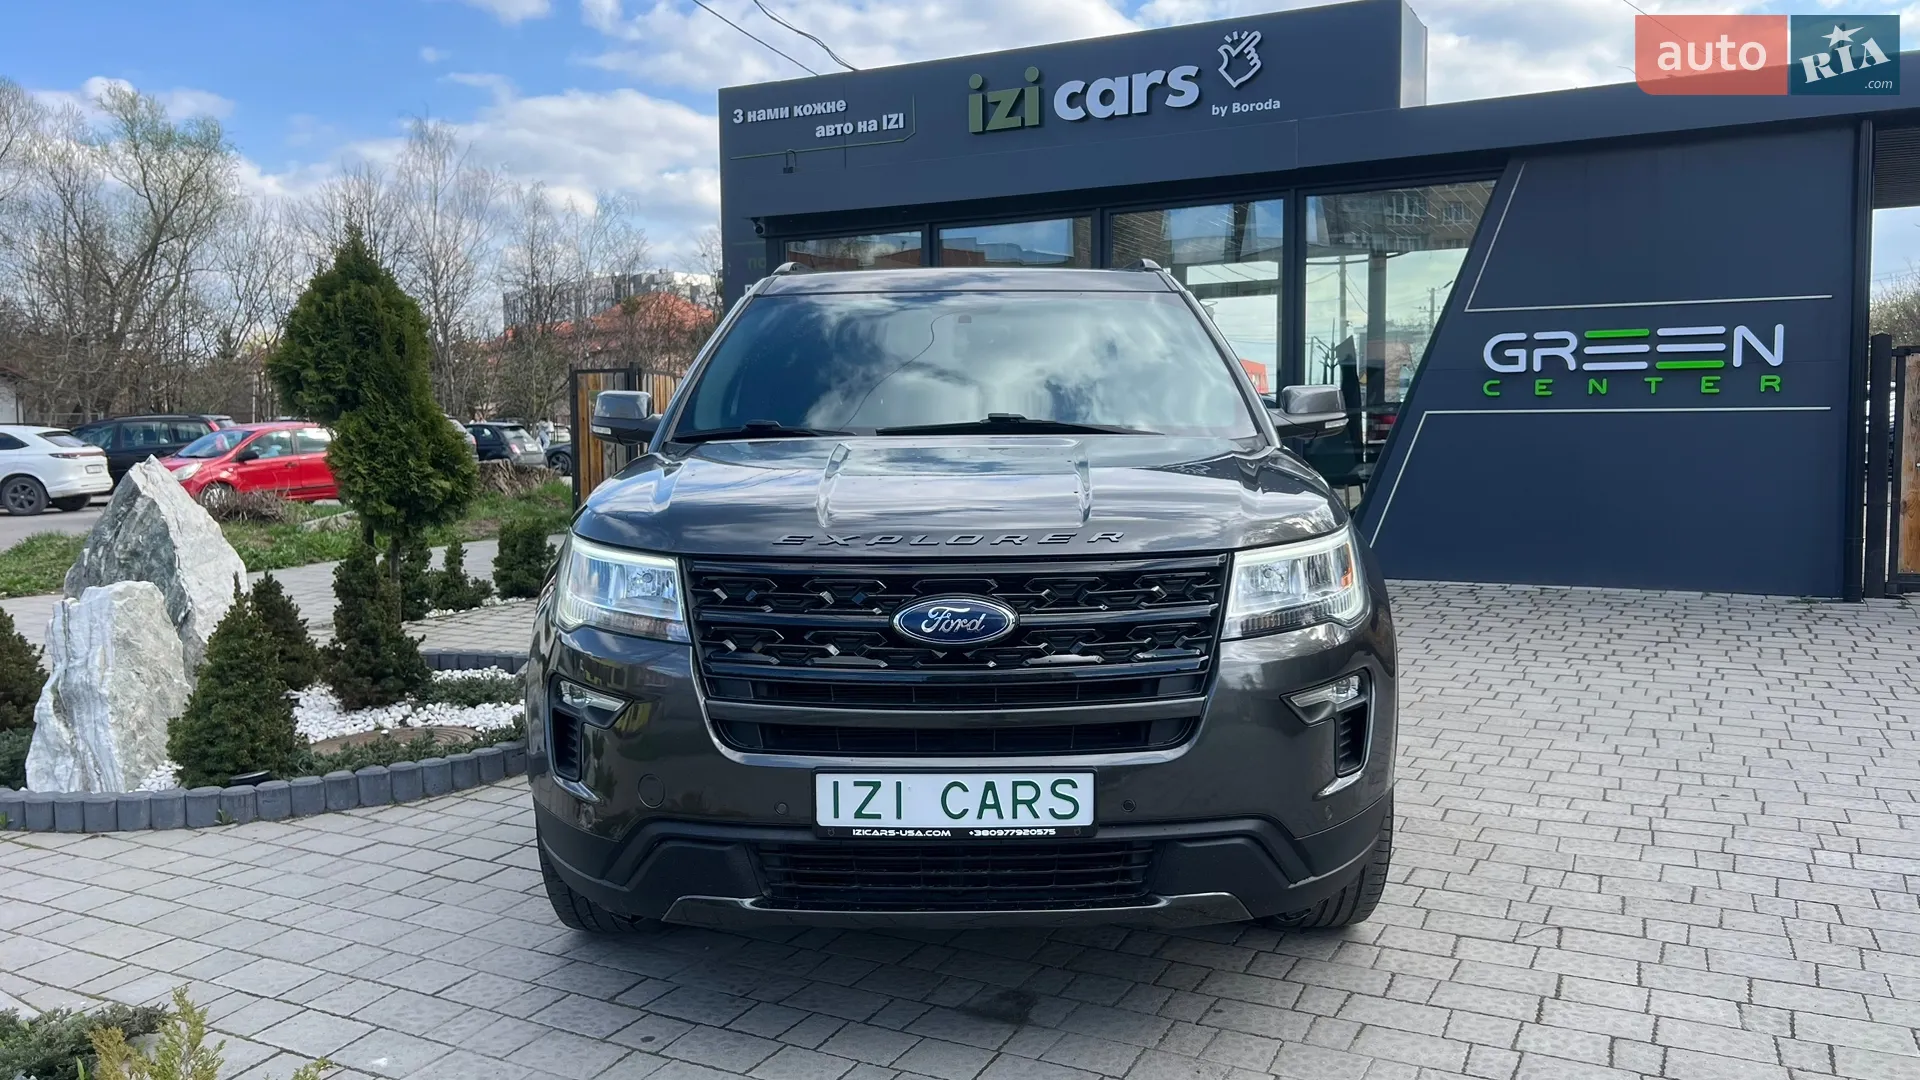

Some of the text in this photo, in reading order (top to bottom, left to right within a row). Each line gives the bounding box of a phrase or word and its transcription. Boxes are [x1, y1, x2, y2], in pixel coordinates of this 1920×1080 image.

[969, 65, 1200, 133] izi cars
[1211, 98, 1281, 117] by Boroda
[747, 106, 789, 122] нами
[793, 100, 847, 117] кожне
[815, 113, 904, 138] авто на IZI
[1483, 323, 1785, 374] GREEN
[1482, 375, 1781, 397] CENTER
[772, 531, 1125, 547] EXPLORER
[921, 606, 986, 634] Ford
[832, 778, 1080, 820] IZI CARS
[852, 828, 951, 837] IZICARS-USA.COM
